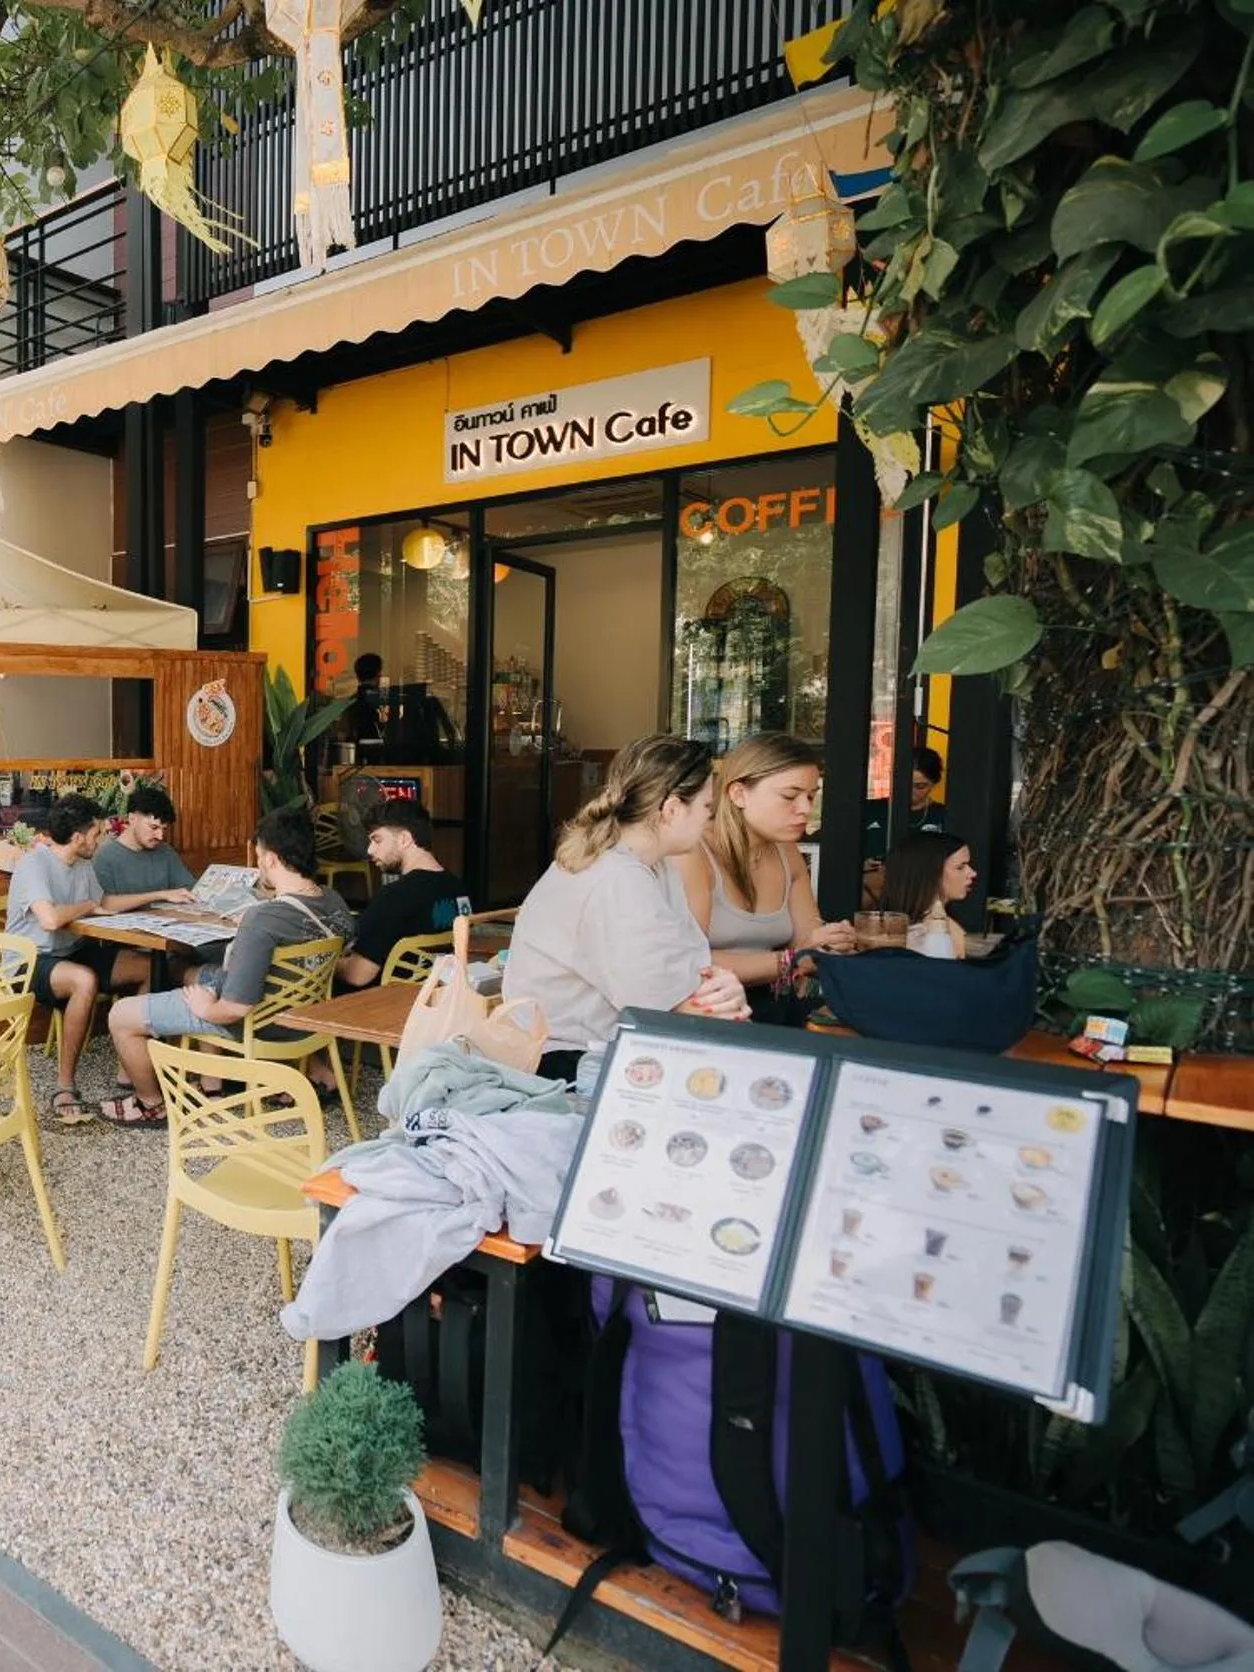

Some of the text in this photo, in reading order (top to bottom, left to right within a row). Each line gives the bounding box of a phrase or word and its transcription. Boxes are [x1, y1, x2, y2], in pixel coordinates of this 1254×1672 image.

[453, 151, 800, 298] IN TOWN Caf
[450, 402, 694, 471] IN TOWN Cafe
[679, 487, 836, 537] COFF
